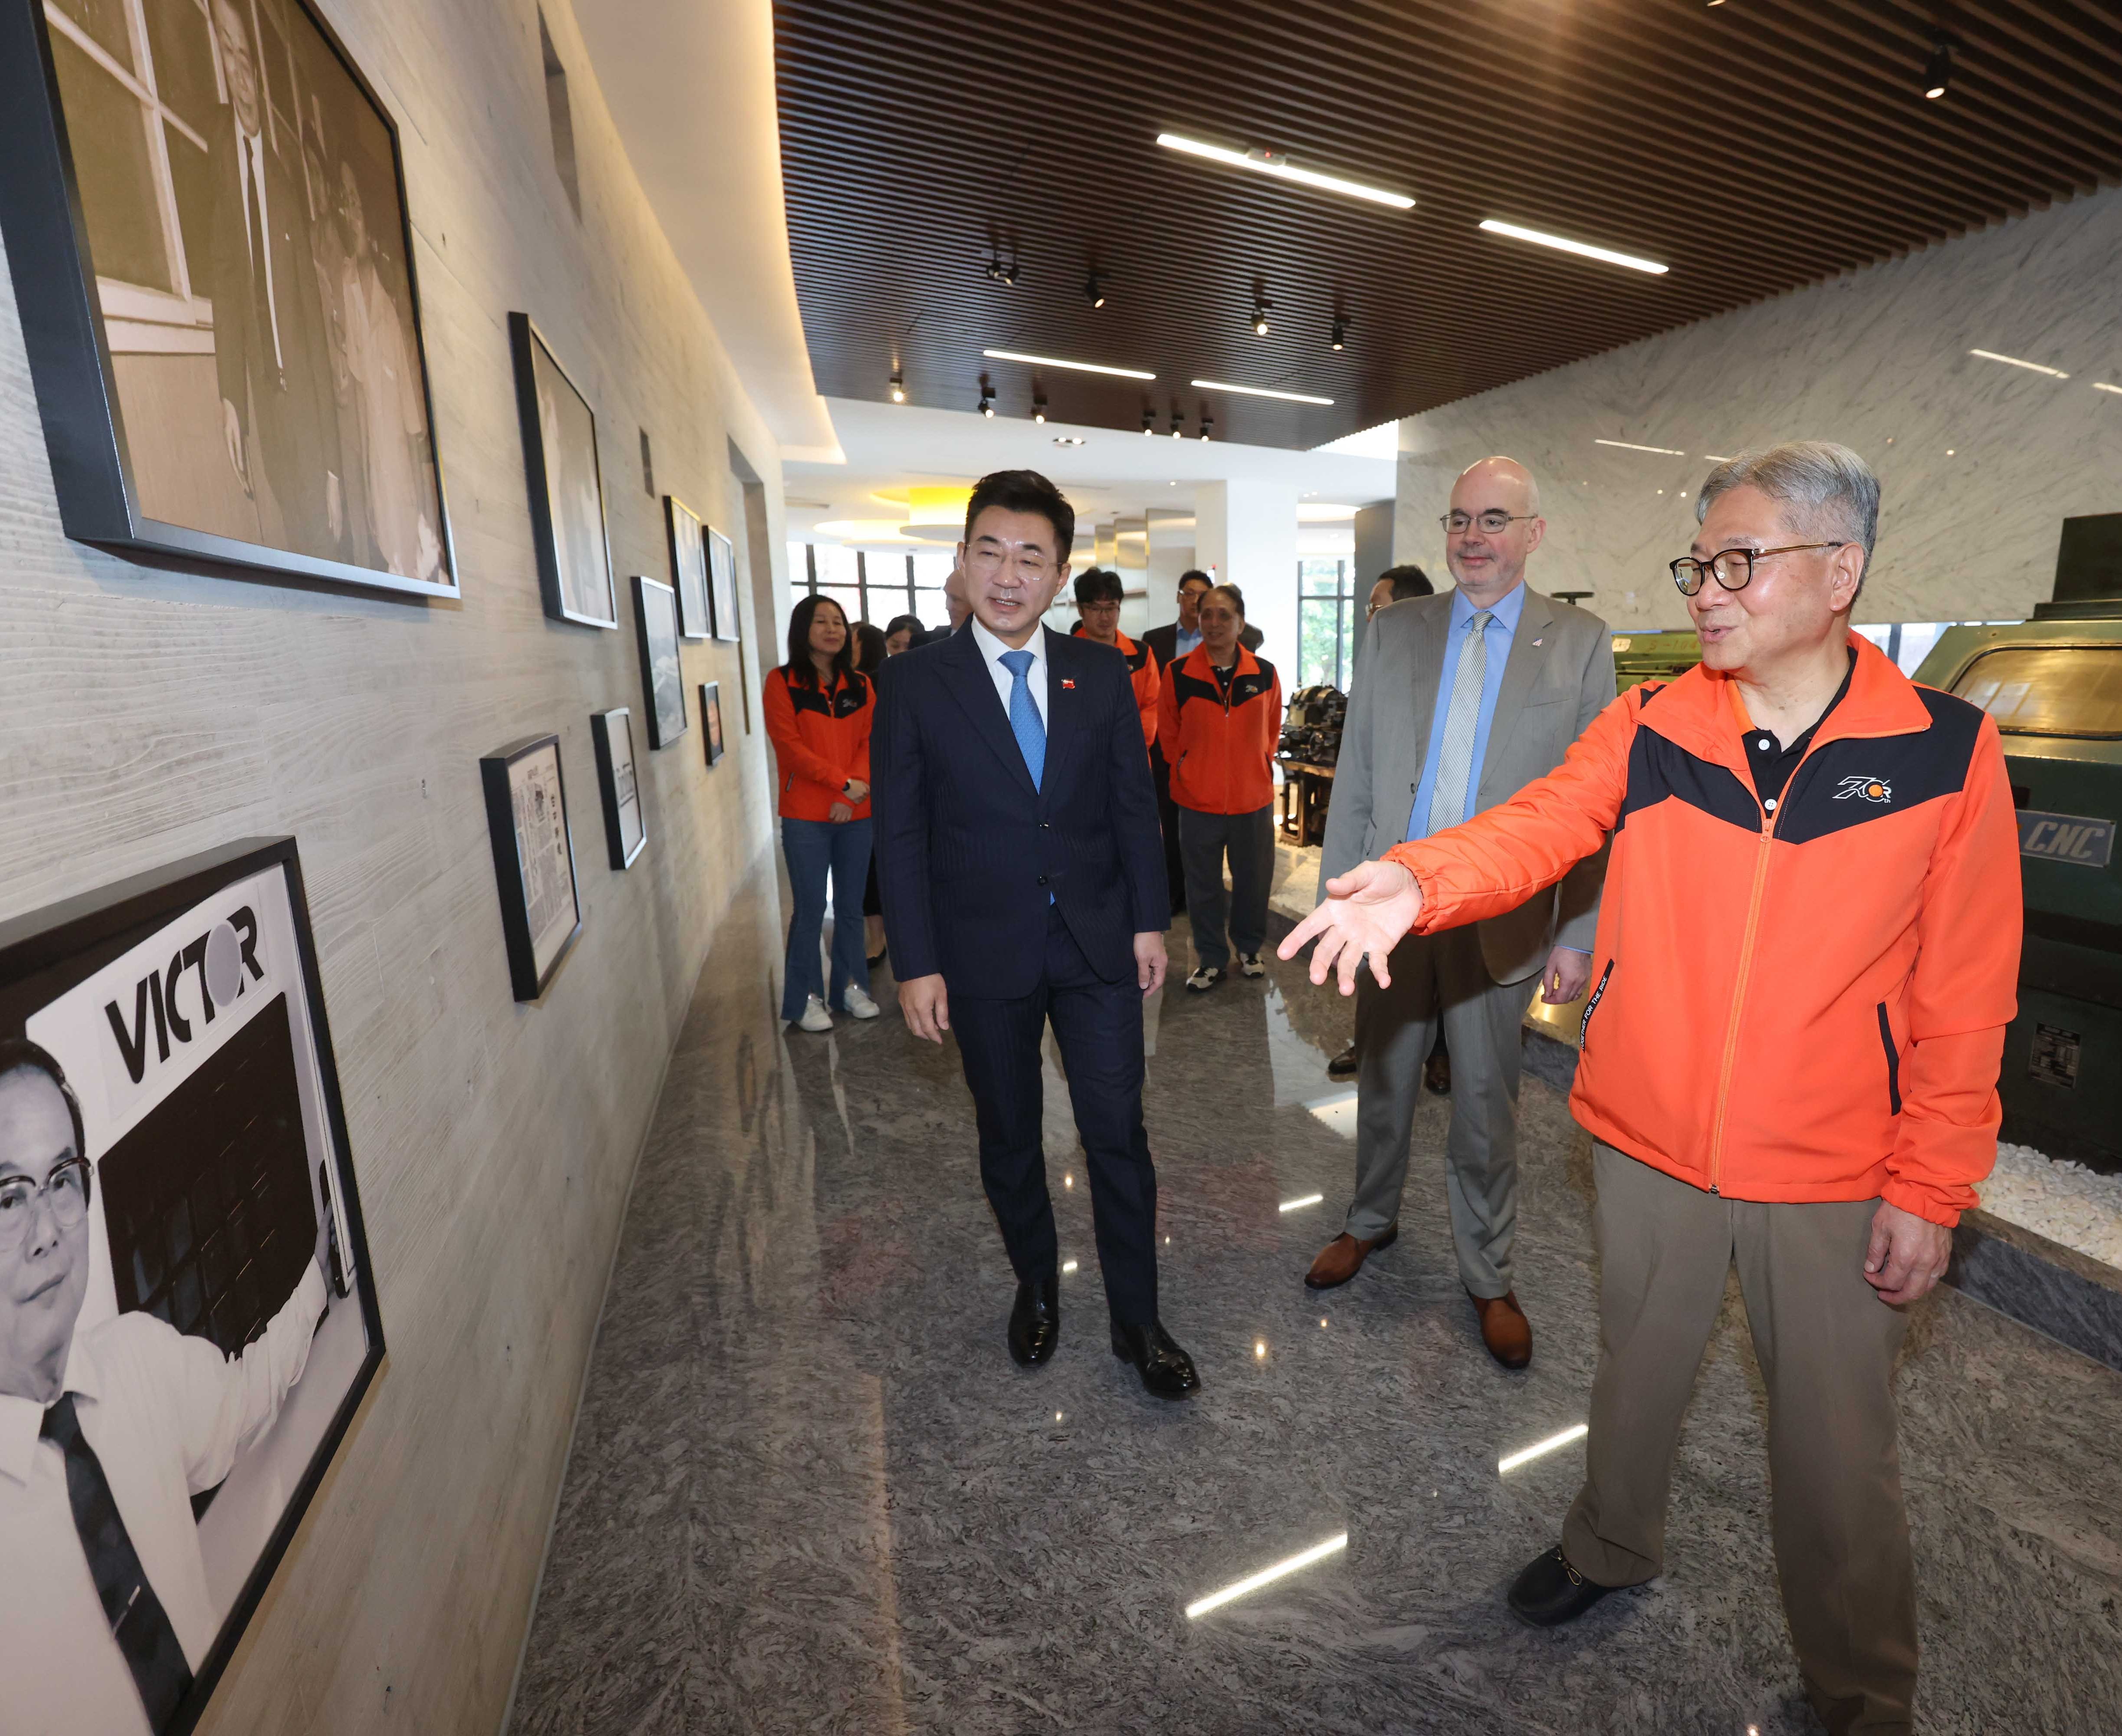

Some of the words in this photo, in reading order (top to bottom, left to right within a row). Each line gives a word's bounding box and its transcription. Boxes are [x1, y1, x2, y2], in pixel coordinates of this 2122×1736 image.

[2024, 821, 2105, 858] CNC
[104, 906, 264, 1084] VICTOR
[1584, 1005, 1594, 1019] FOR
[1591, 991, 1601, 1004] THE
[1599, 975, 1608, 991] RIDE
